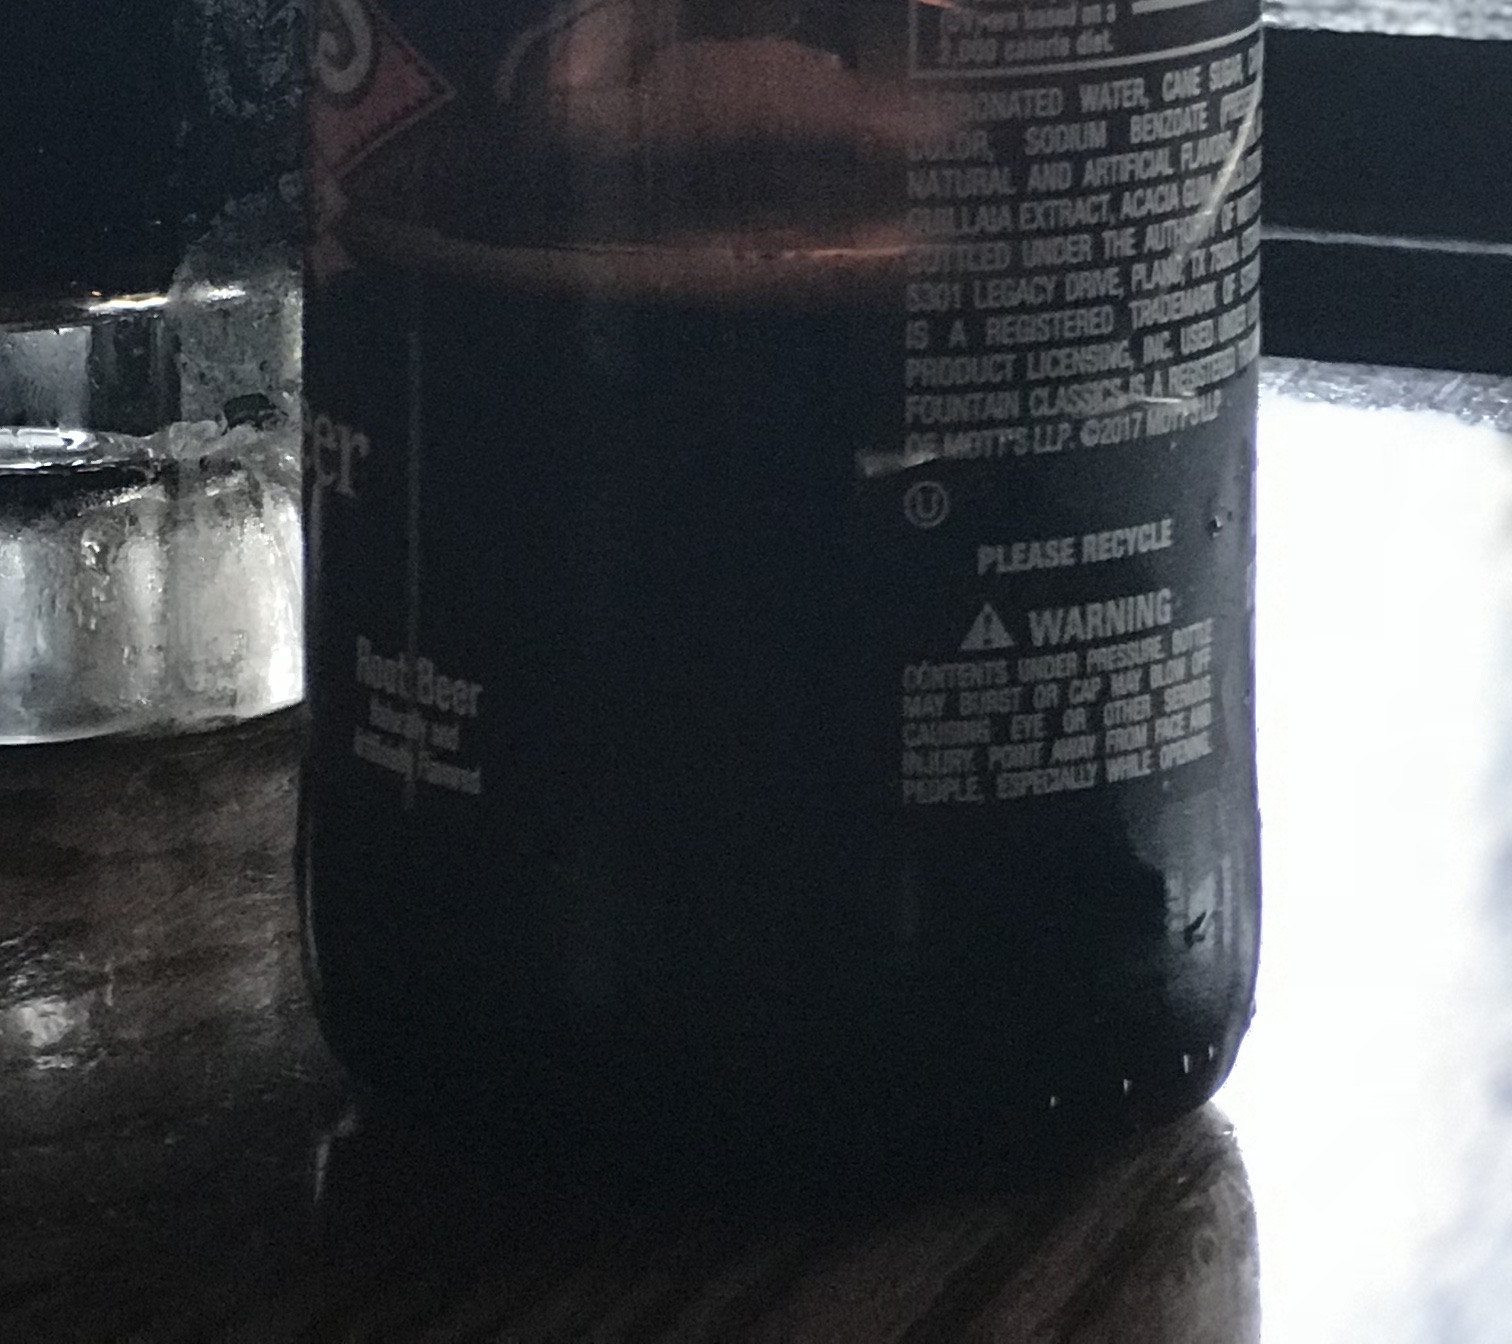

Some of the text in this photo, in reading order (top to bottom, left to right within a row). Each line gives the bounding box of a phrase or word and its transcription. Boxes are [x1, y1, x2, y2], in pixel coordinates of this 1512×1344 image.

[1079, 77, 1149, 114] WATER,
[1024, 120, 1108, 156] SODIUM
[907, 166, 1018, 201] NATURAL
[1028, 160, 1072, 195] AND
[1120, 182, 1179, 220] ACACIA
[1022, 233, 1092, 269] UNDER
[1102, 227, 1136, 260] THE
[973, 274, 1057, 310] LEGACY
[1065, 266, 1125, 302] DRIVE,
[905, 319, 930, 350] IS
[948, 318, 967, 349] A
[985, 304, 1115, 347] REGISTERED
[905, 353, 1018, 389] PRODUCT
[904, 391, 1020, 425] FOUNTAIN
[977, 518, 1172, 577] PLEASE RECYCLE
[1028, 588, 1172, 648] WARNING
[1017, 651, 1079, 683] UNDER
[1068, 676, 1102, 705] CAP
